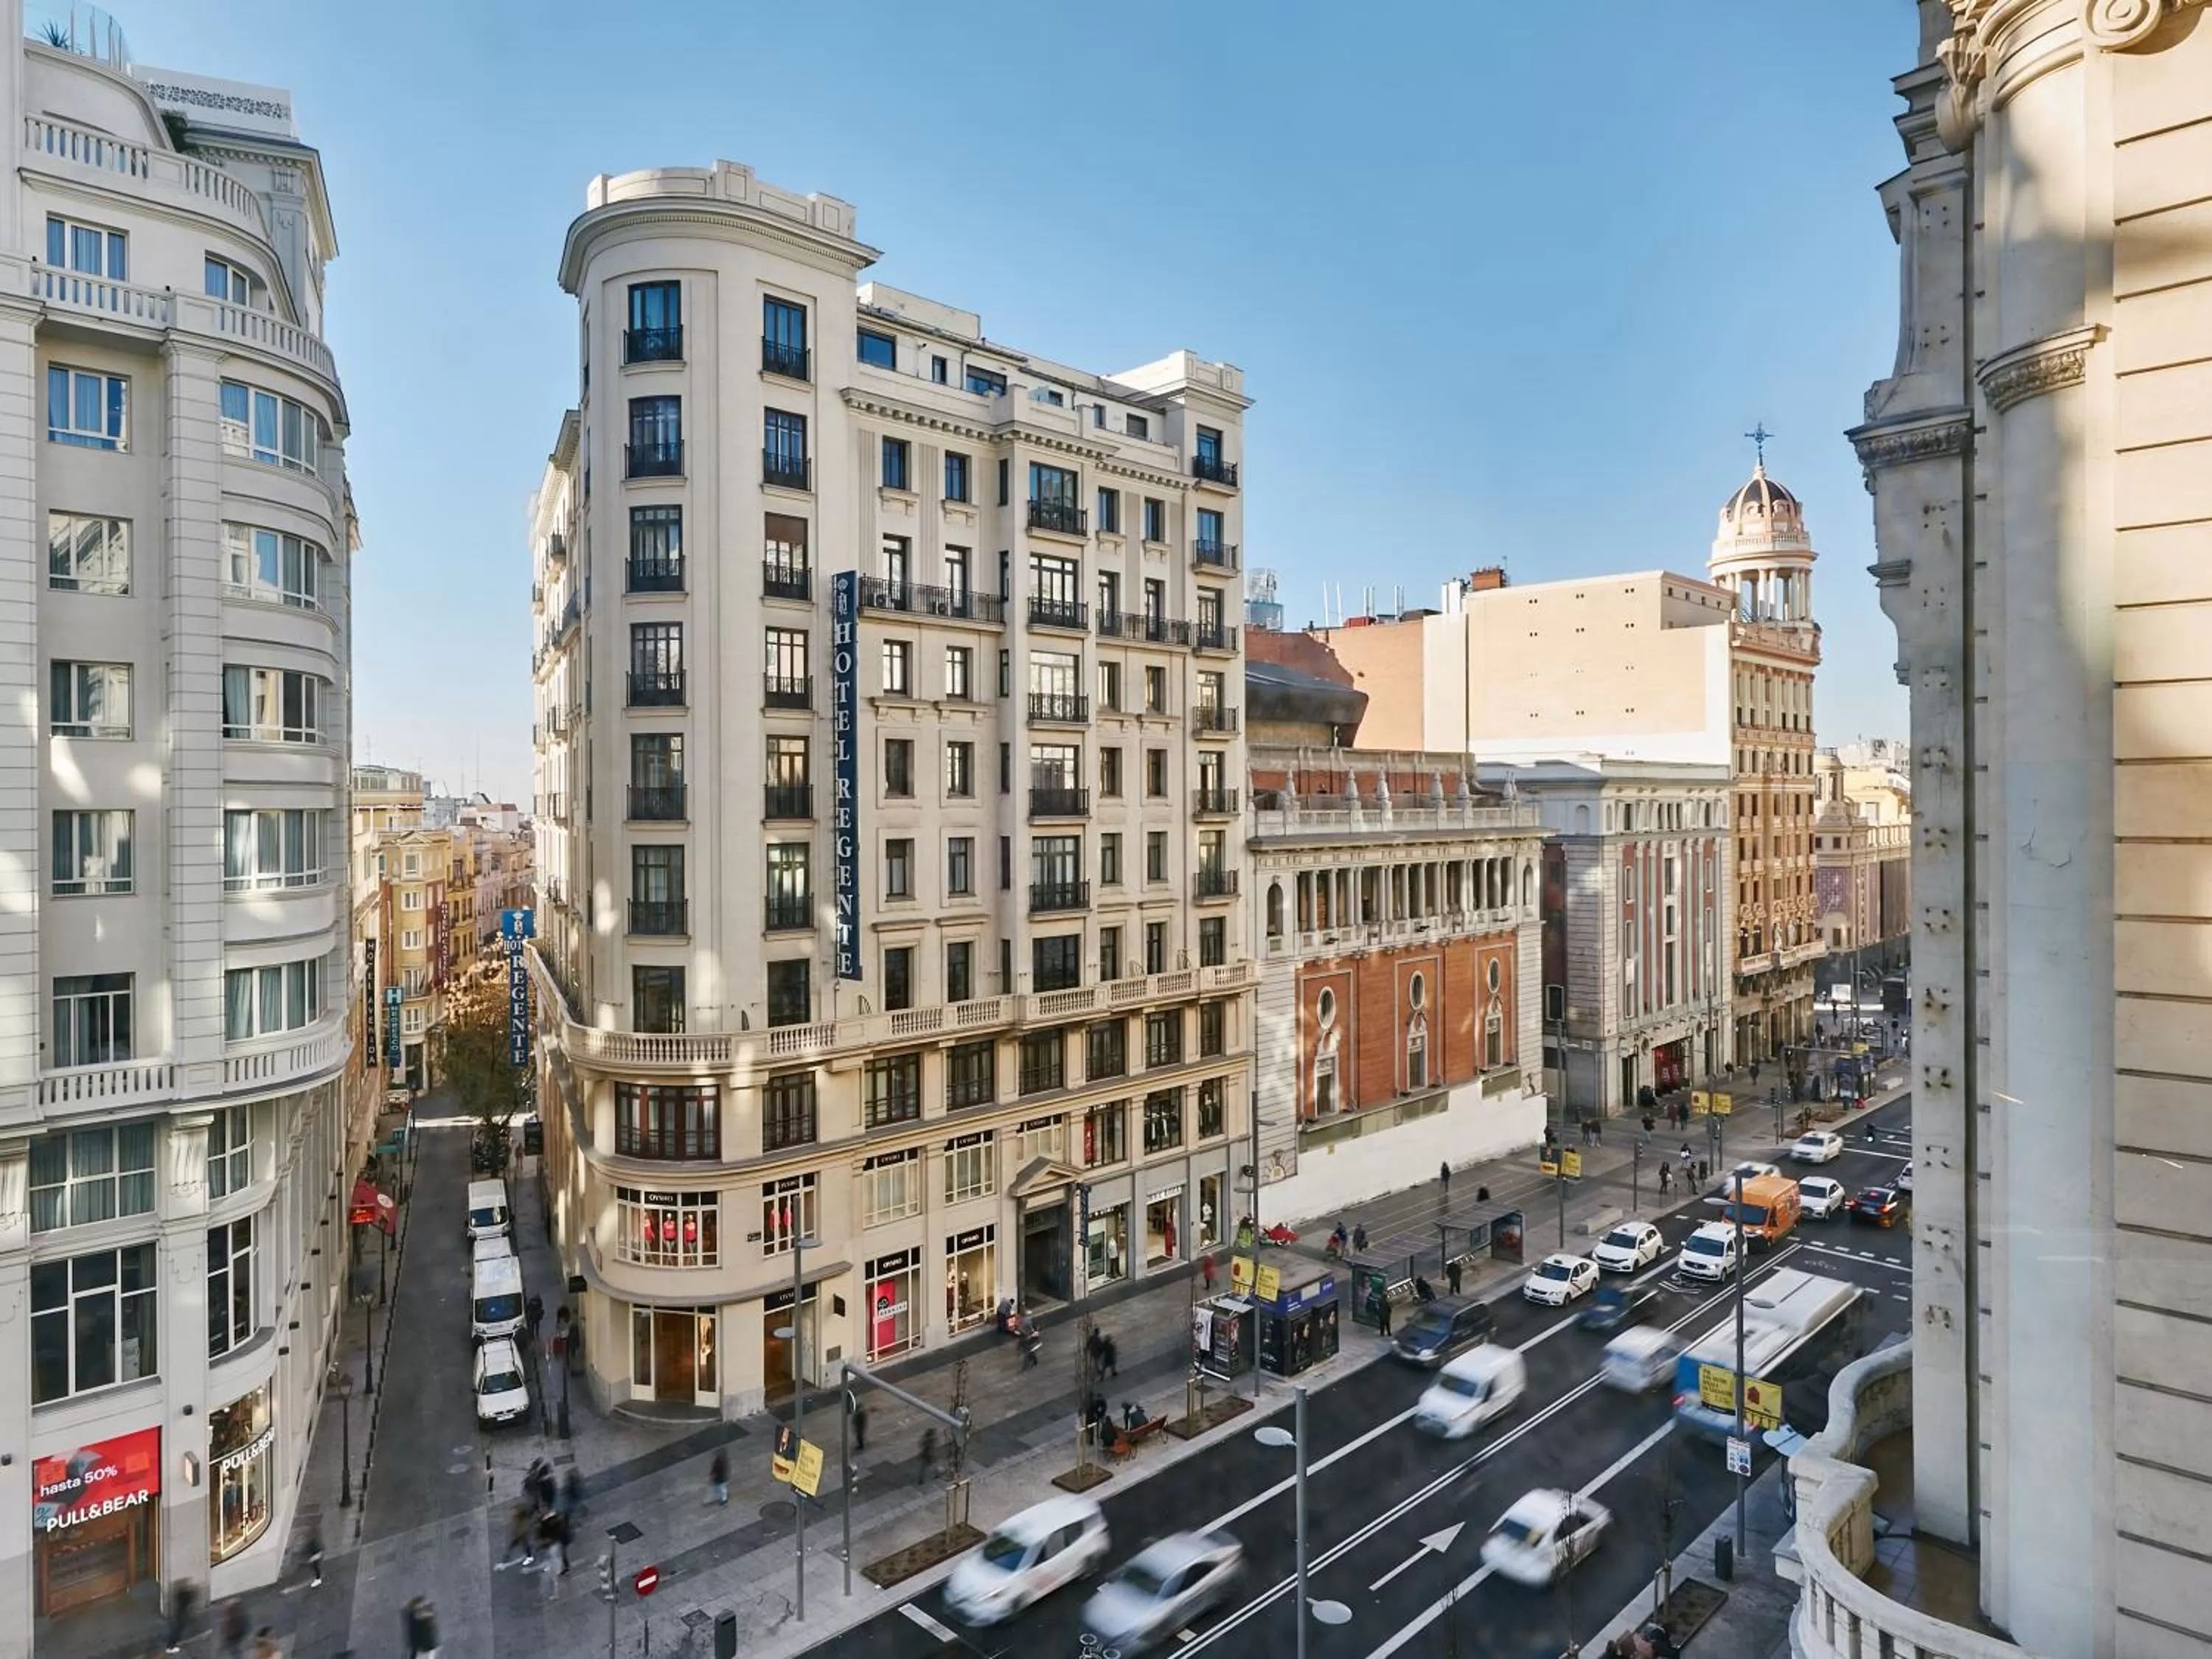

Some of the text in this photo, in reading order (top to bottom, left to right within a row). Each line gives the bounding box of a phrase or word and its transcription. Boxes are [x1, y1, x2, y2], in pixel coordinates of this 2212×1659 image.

[835, 622, 853, 974] HOTEL REGENTE
[512, 956, 525, 1062] REGENTE
[41, 1464, 118, 1498] hasta 50%
[46, 1489, 149, 1533] PULL&BEAR
